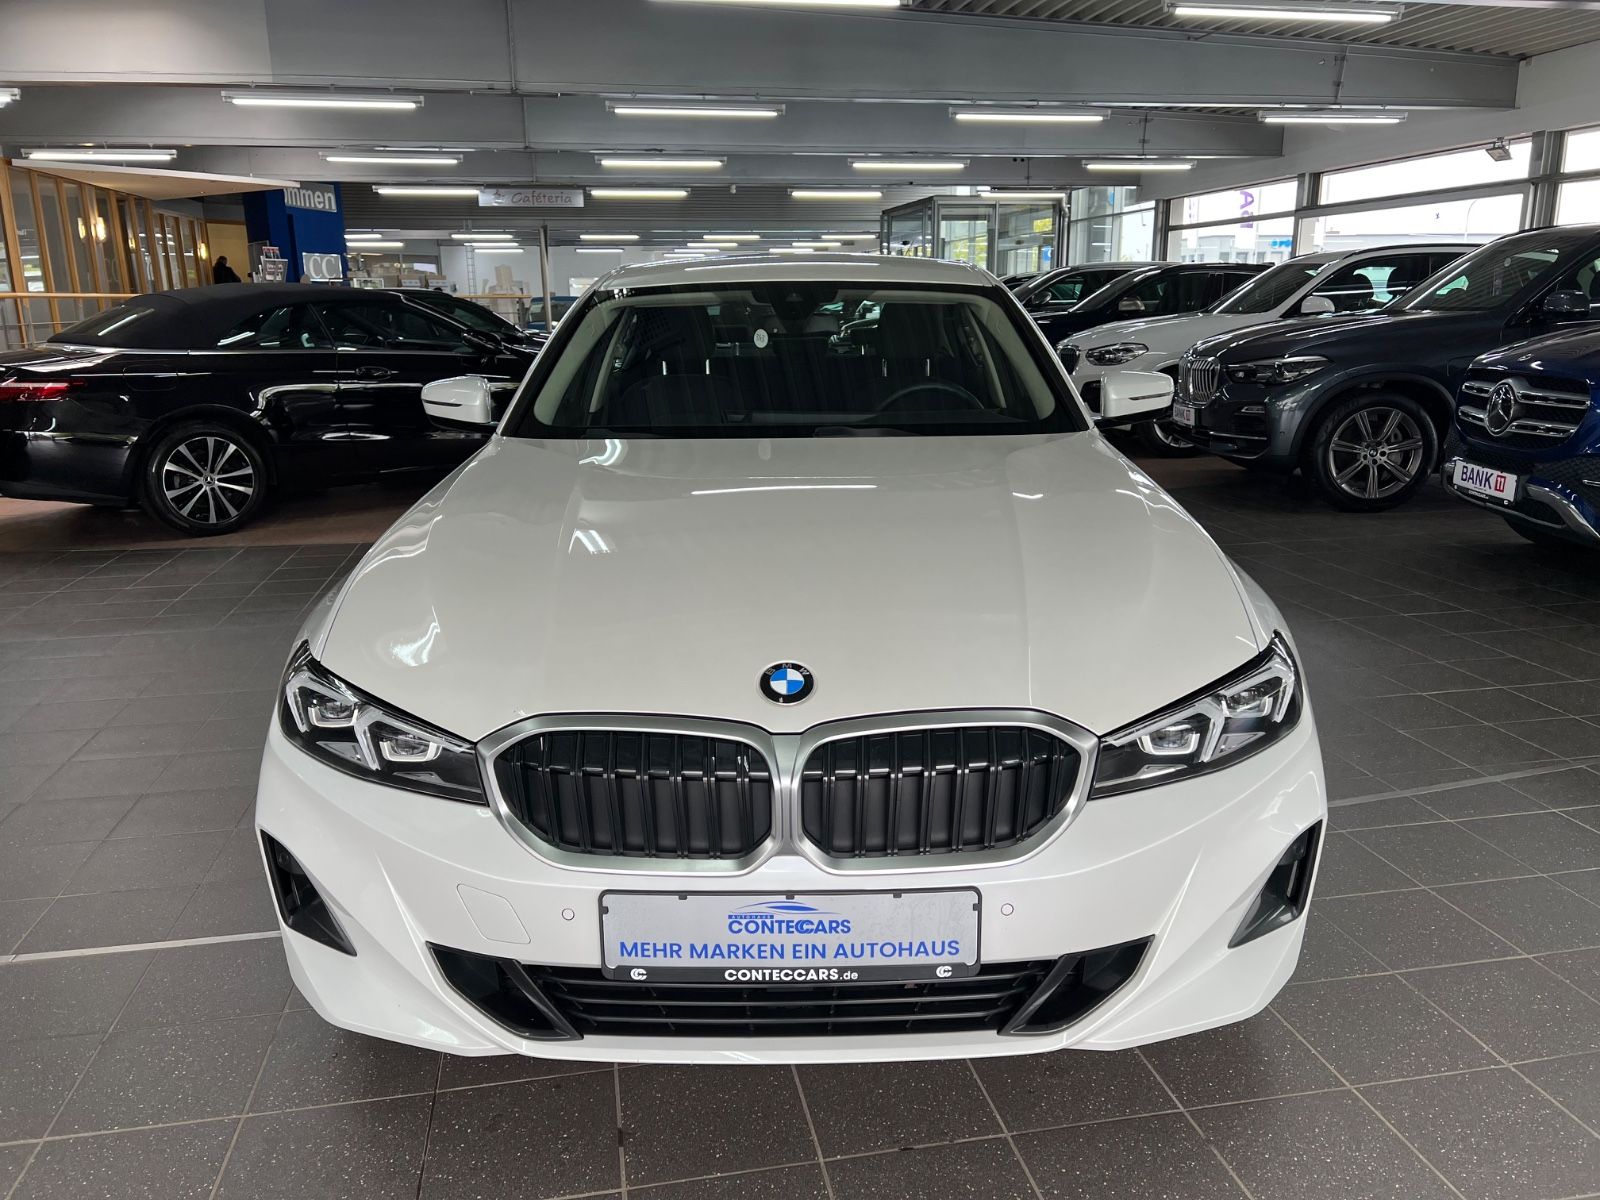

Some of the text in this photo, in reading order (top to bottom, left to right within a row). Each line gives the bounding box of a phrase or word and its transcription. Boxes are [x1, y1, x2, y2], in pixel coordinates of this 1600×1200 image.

[309, 255, 336, 279] CC
[1460, 465, 1494, 490] BANK
[764, 663, 810, 676] BMW
[728, 919, 851, 934] CONTECCARS
[619, 940, 960, 959] MEHR MARKEN EIN AUTOHAUS
[724, 968, 859, 981] CONTECCARS.de
